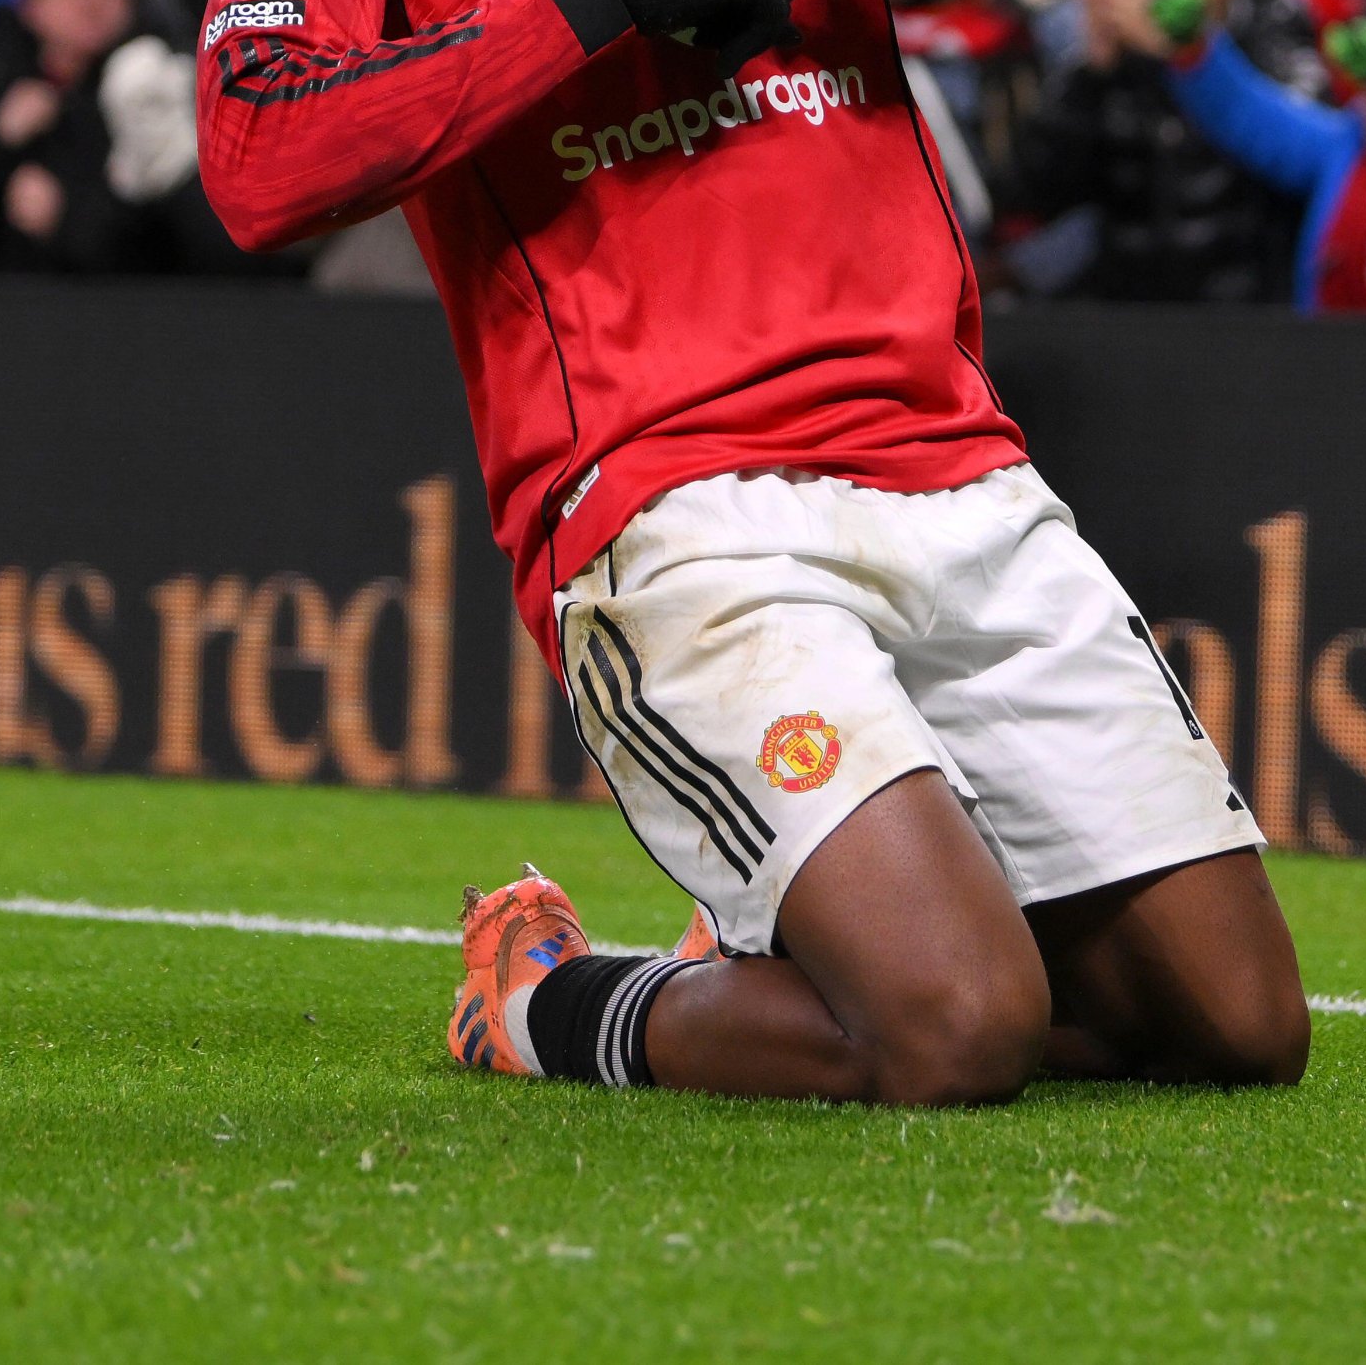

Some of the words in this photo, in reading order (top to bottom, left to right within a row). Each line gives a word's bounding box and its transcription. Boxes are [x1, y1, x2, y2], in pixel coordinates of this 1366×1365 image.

[206, 10, 228, 36] No
[230, 1, 294, 15] room
[227, 13, 303, 27] racism
[551, 65, 866, 182] Snapdragon
[147, 472, 458, 790] red
[764, 718, 817, 766] MANCHESTER
[798, 754, 836, 789] UNITED
